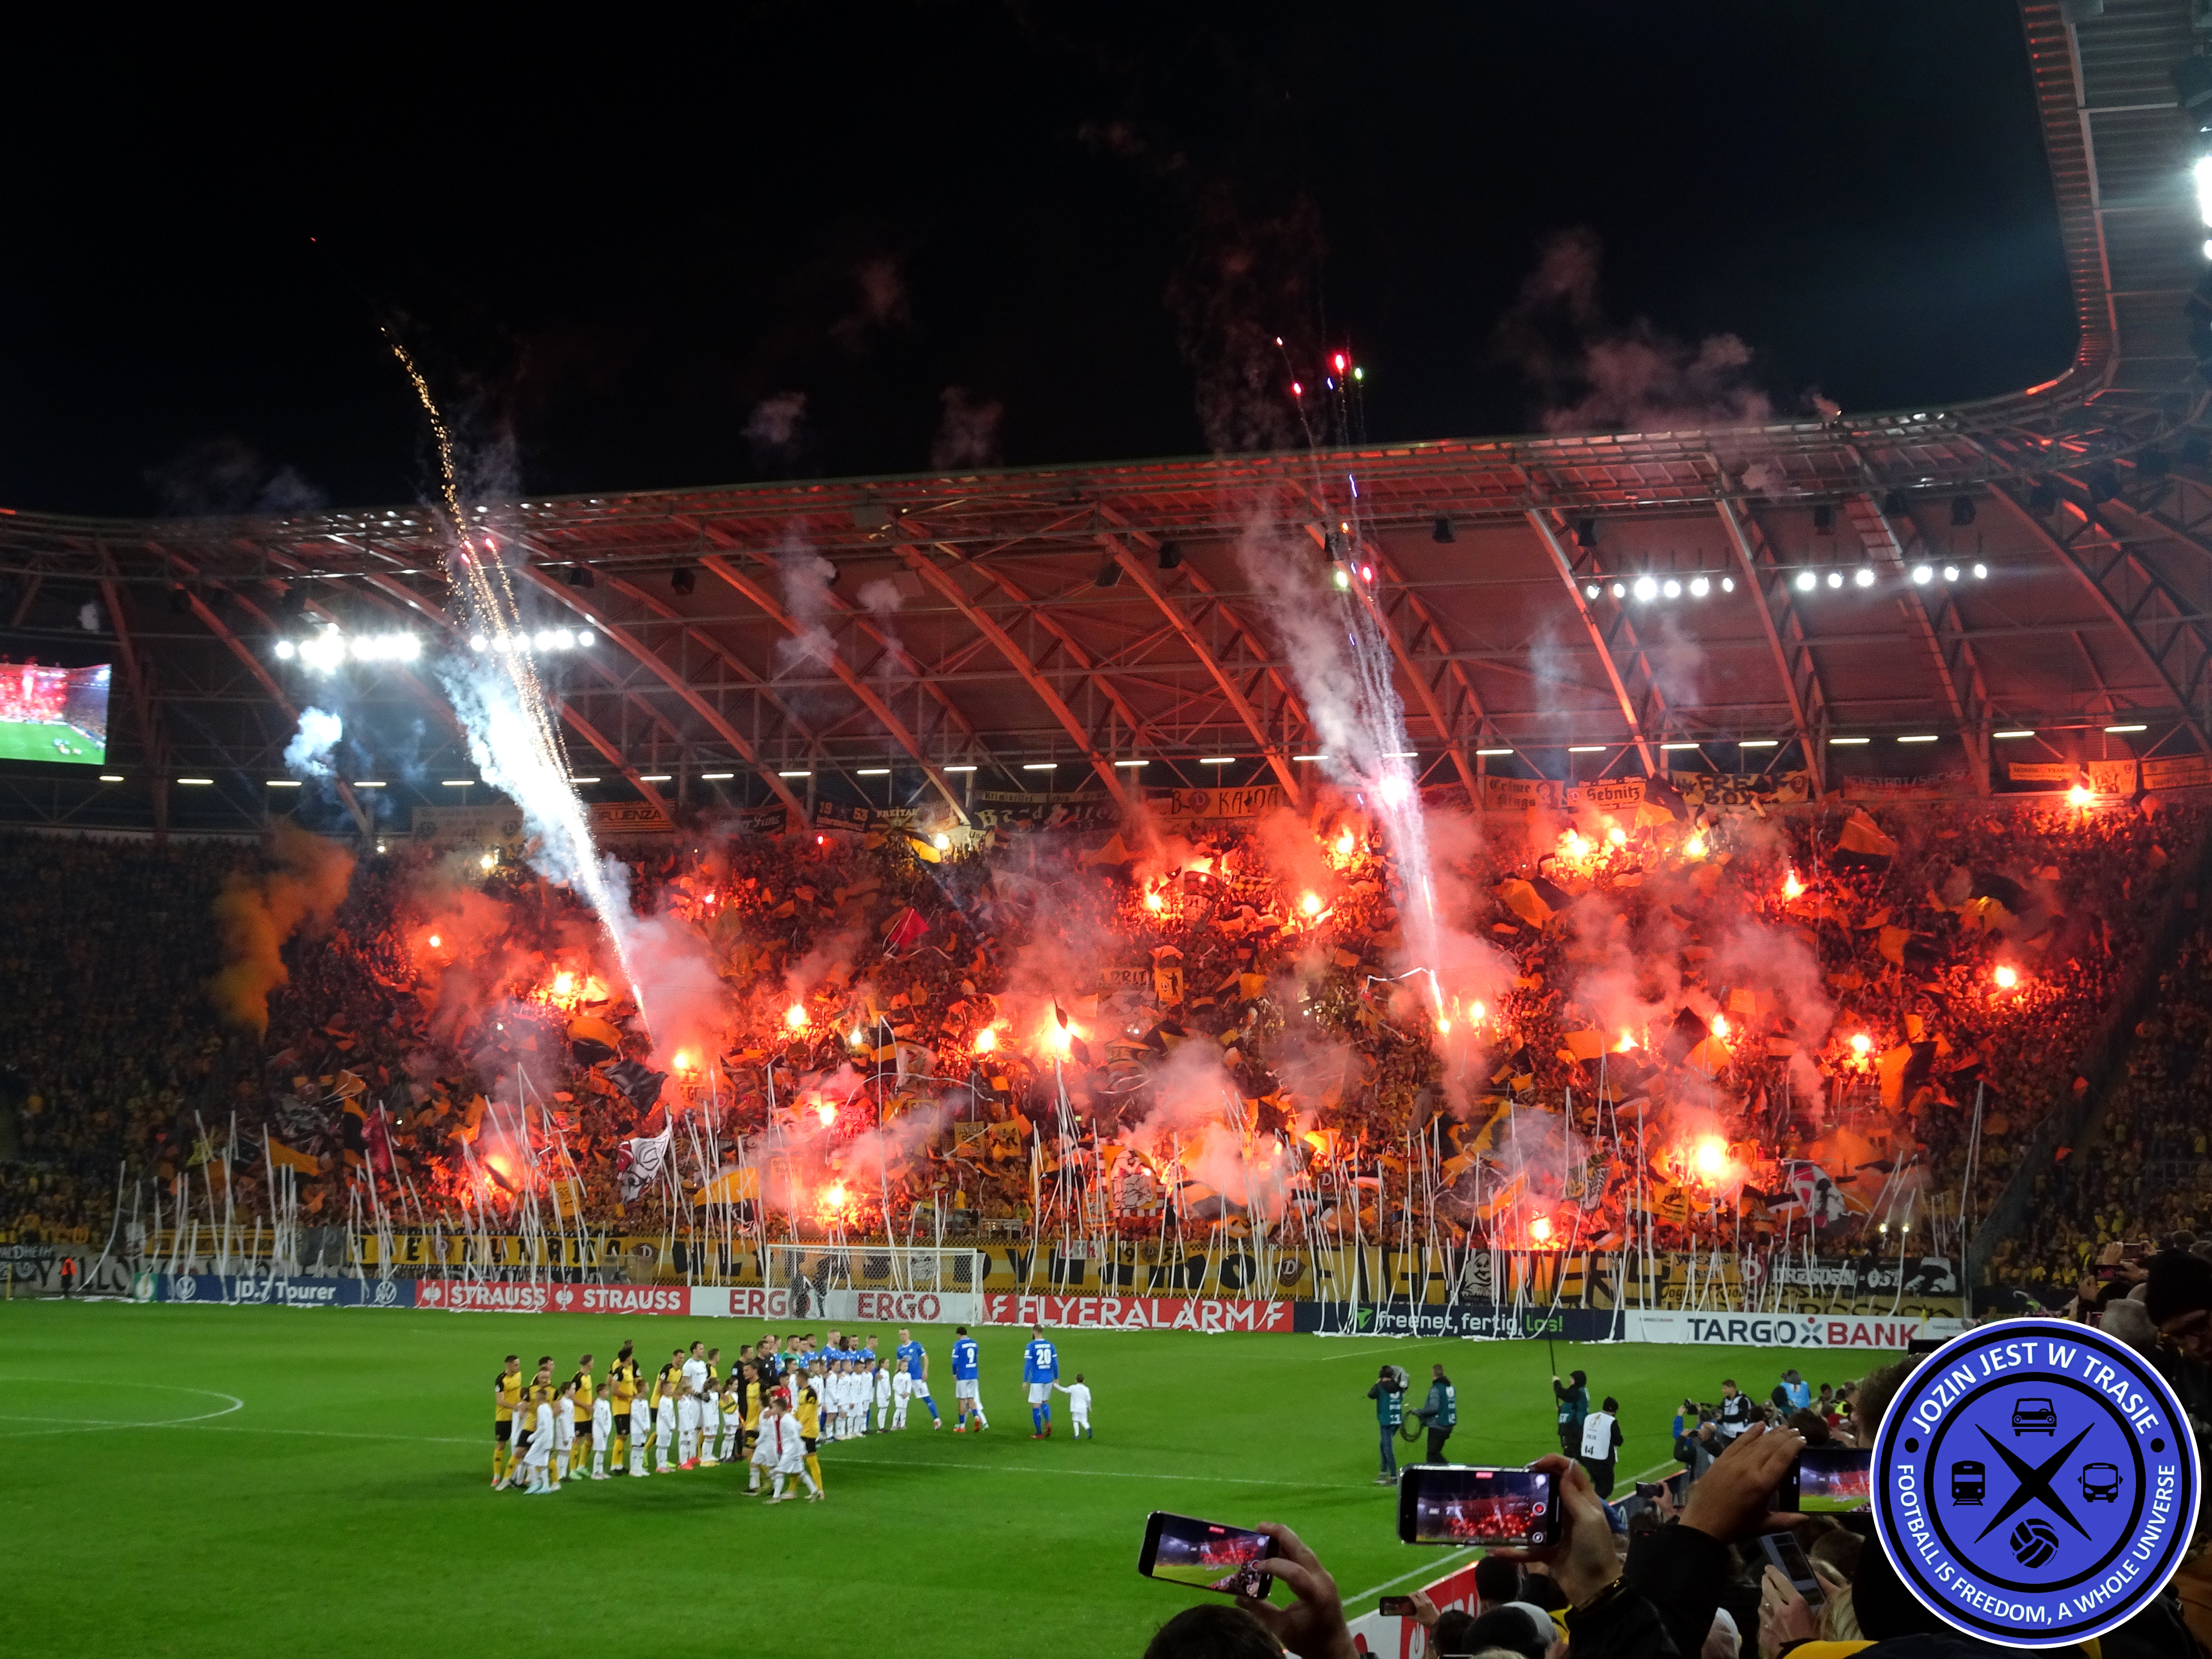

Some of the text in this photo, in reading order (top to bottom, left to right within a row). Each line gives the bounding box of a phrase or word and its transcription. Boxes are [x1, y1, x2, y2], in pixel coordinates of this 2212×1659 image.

[1587, 786, 1640, 801] Sebnitz
[275, 1281, 337, 1300] Tourer
[451, 1285, 546, 1307] STRAUSS
[582, 1288, 681, 1311] STRAUSS
[858, 1293, 941, 1321] ERGO
[1019, 1297, 1255, 1330] FLYERALARM
[1526, 1314, 1563, 1332] los!
[967, 1347, 975, 1364] 9
[1036, 1348, 1052, 1365] 20
